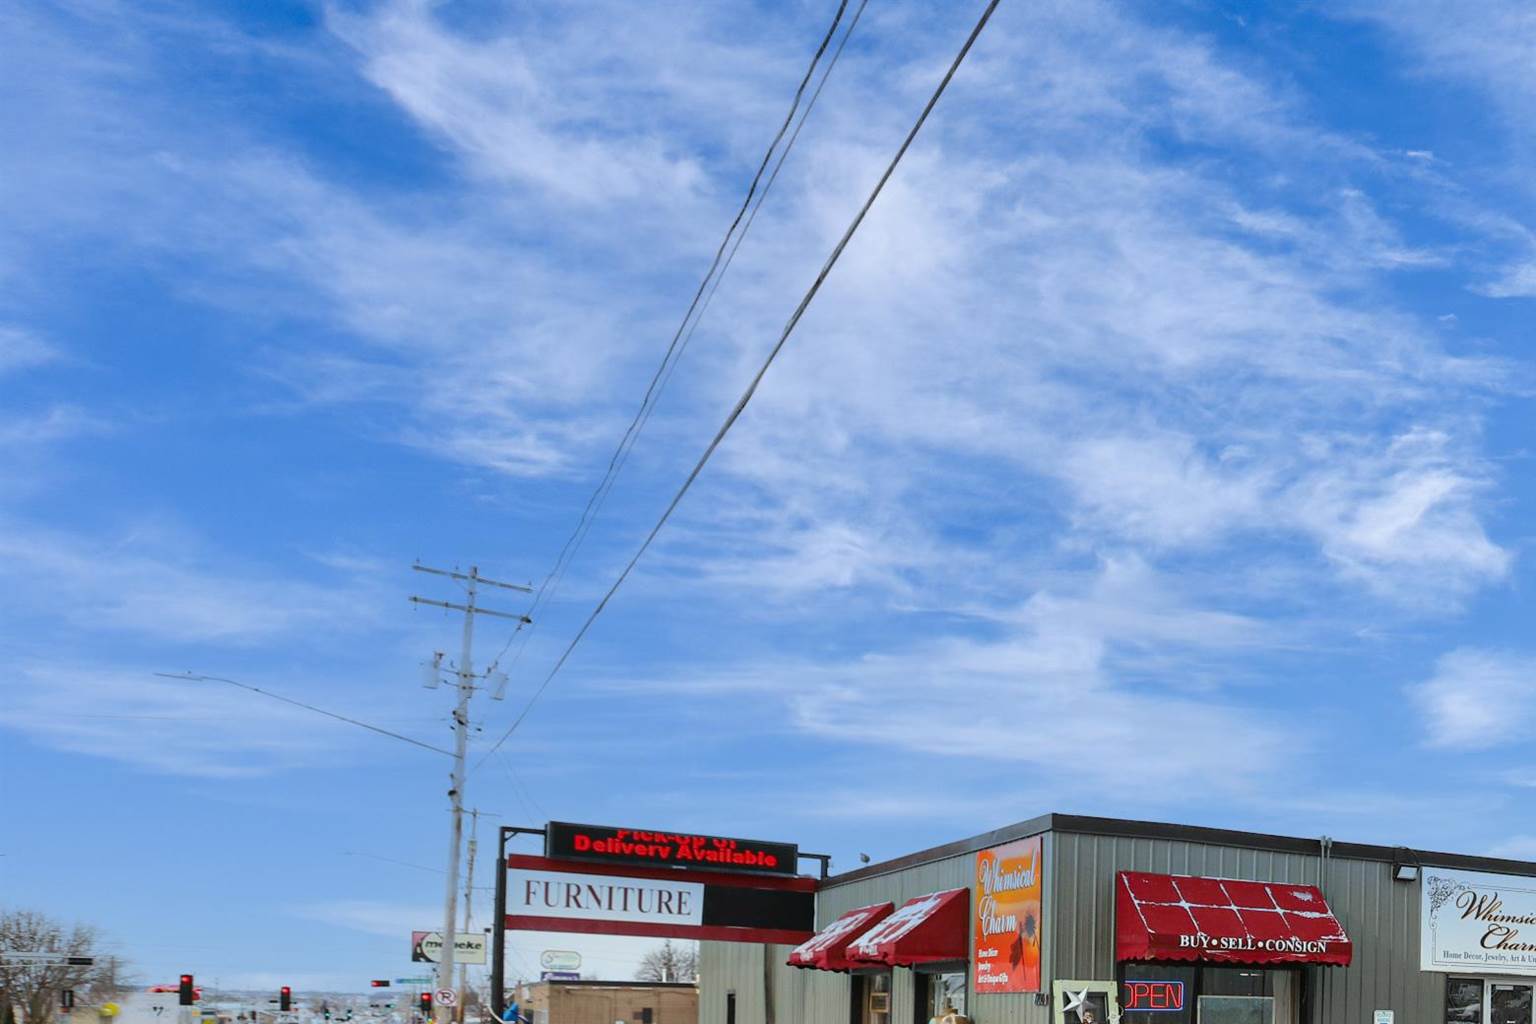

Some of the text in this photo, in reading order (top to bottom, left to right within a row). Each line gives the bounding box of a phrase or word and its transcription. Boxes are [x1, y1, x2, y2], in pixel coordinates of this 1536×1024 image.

[573, 834, 778, 867] Delivery Available
[978, 847, 1037, 894] Whimsical
[524, 879, 692, 916] FURNITURE
[978, 895, 1017, 937] Charm
[1180, 934, 1327, 953] BUY SELL CONSIGN
[1443, 950, 1461, 959] Home
[1123, 983, 1181, 1008] OPEN
